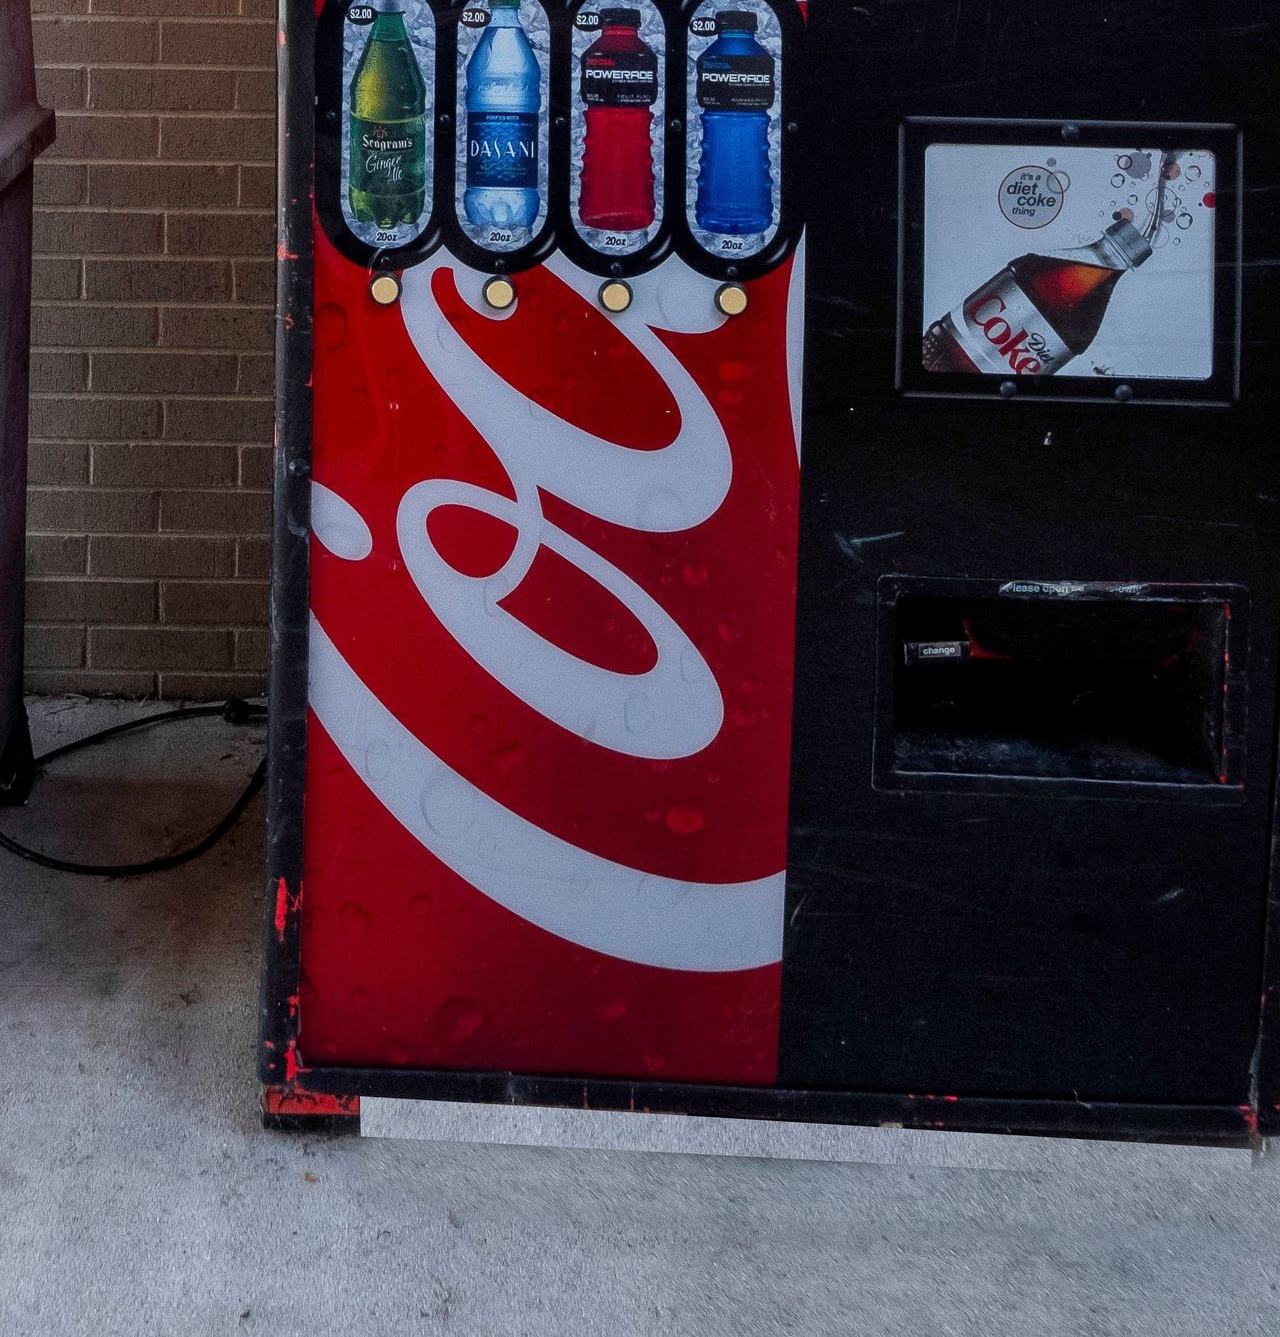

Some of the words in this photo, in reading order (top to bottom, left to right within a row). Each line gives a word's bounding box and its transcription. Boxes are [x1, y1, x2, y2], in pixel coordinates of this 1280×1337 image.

[350, 8, 372, 20] $2.00
[463, 11, 485, 23] $2.00
[576, 14, 599, 26] $2.00
[692, 20, 716, 32] $2.00
[585, 70, 653, 80] POWERADE
[702, 73, 770, 83] POWERADE
[362, 134, 413, 151] Seagram's
[471, 136, 534, 161] DASANI
[365, 154, 402, 178] Ginger
[1020, 173, 1034, 181] it's
[1007, 181, 1039, 195] diet
[1017, 193, 1056, 207] coke
[1012, 207, 1036, 217] thing
[376, 231, 397, 242] 20oz
[490, 231, 511, 242] 20oz
[605, 235, 627, 246] 20oz
[721, 239, 744, 250] 20oz
[967, 293, 1041, 375] Coke
[1027, 333, 1056, 363] Diet
